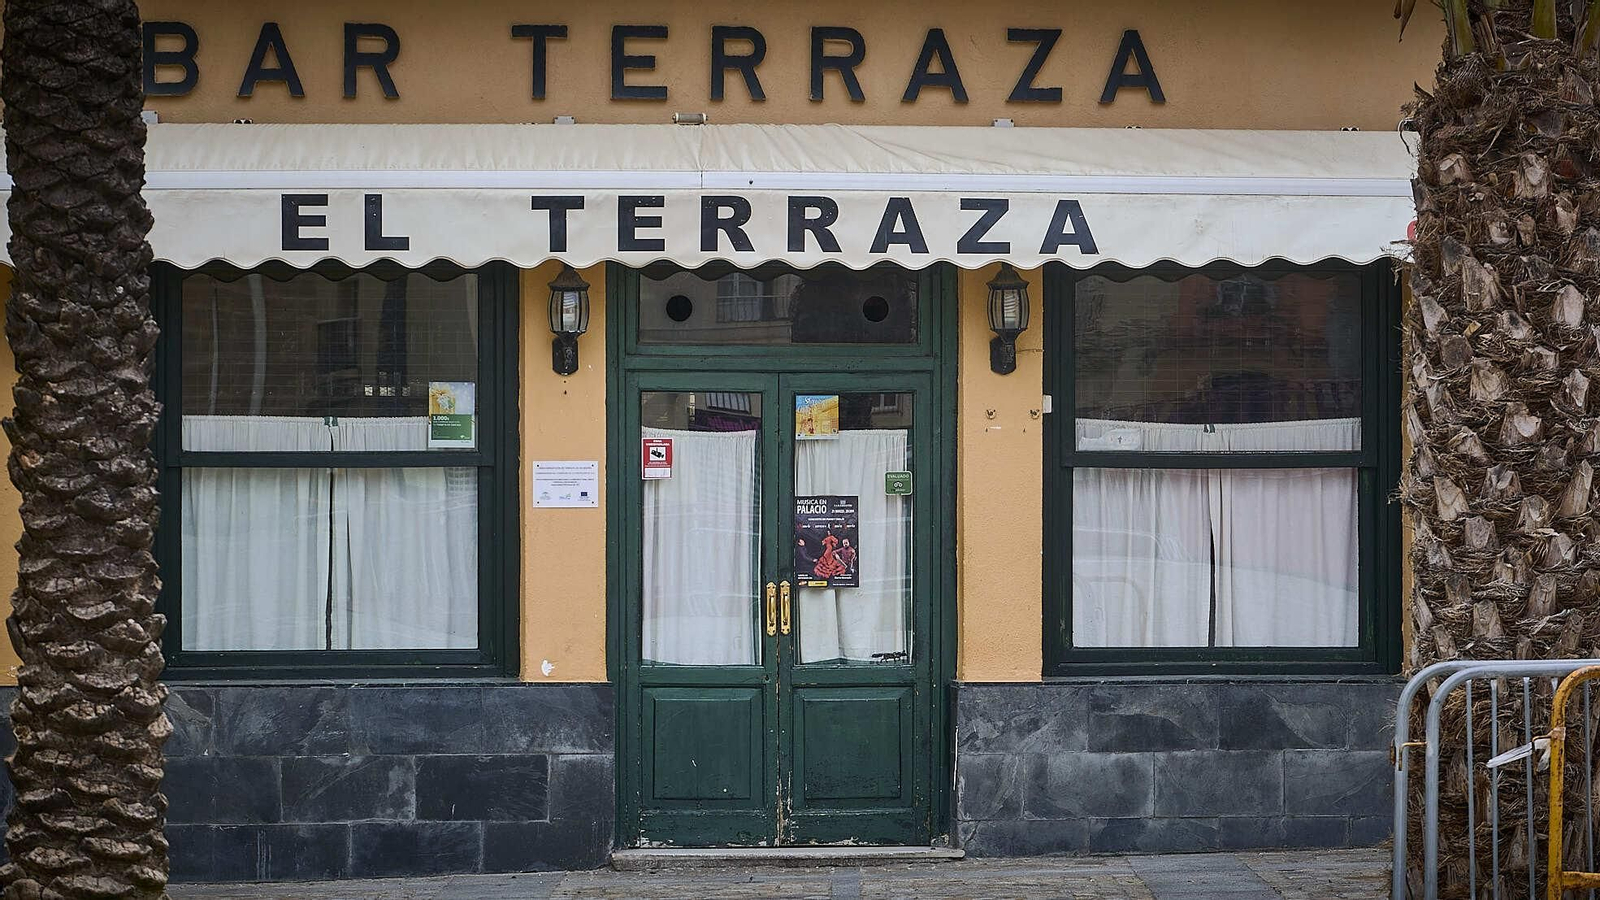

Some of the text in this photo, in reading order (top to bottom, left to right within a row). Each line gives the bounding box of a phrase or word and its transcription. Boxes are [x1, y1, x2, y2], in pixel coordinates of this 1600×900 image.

[142, 21, 1166, 105] BAR TERRAZA
[281, 193, 1099, 255] EL TERRAZA
[796, 505, 827, 514] PALACIO
